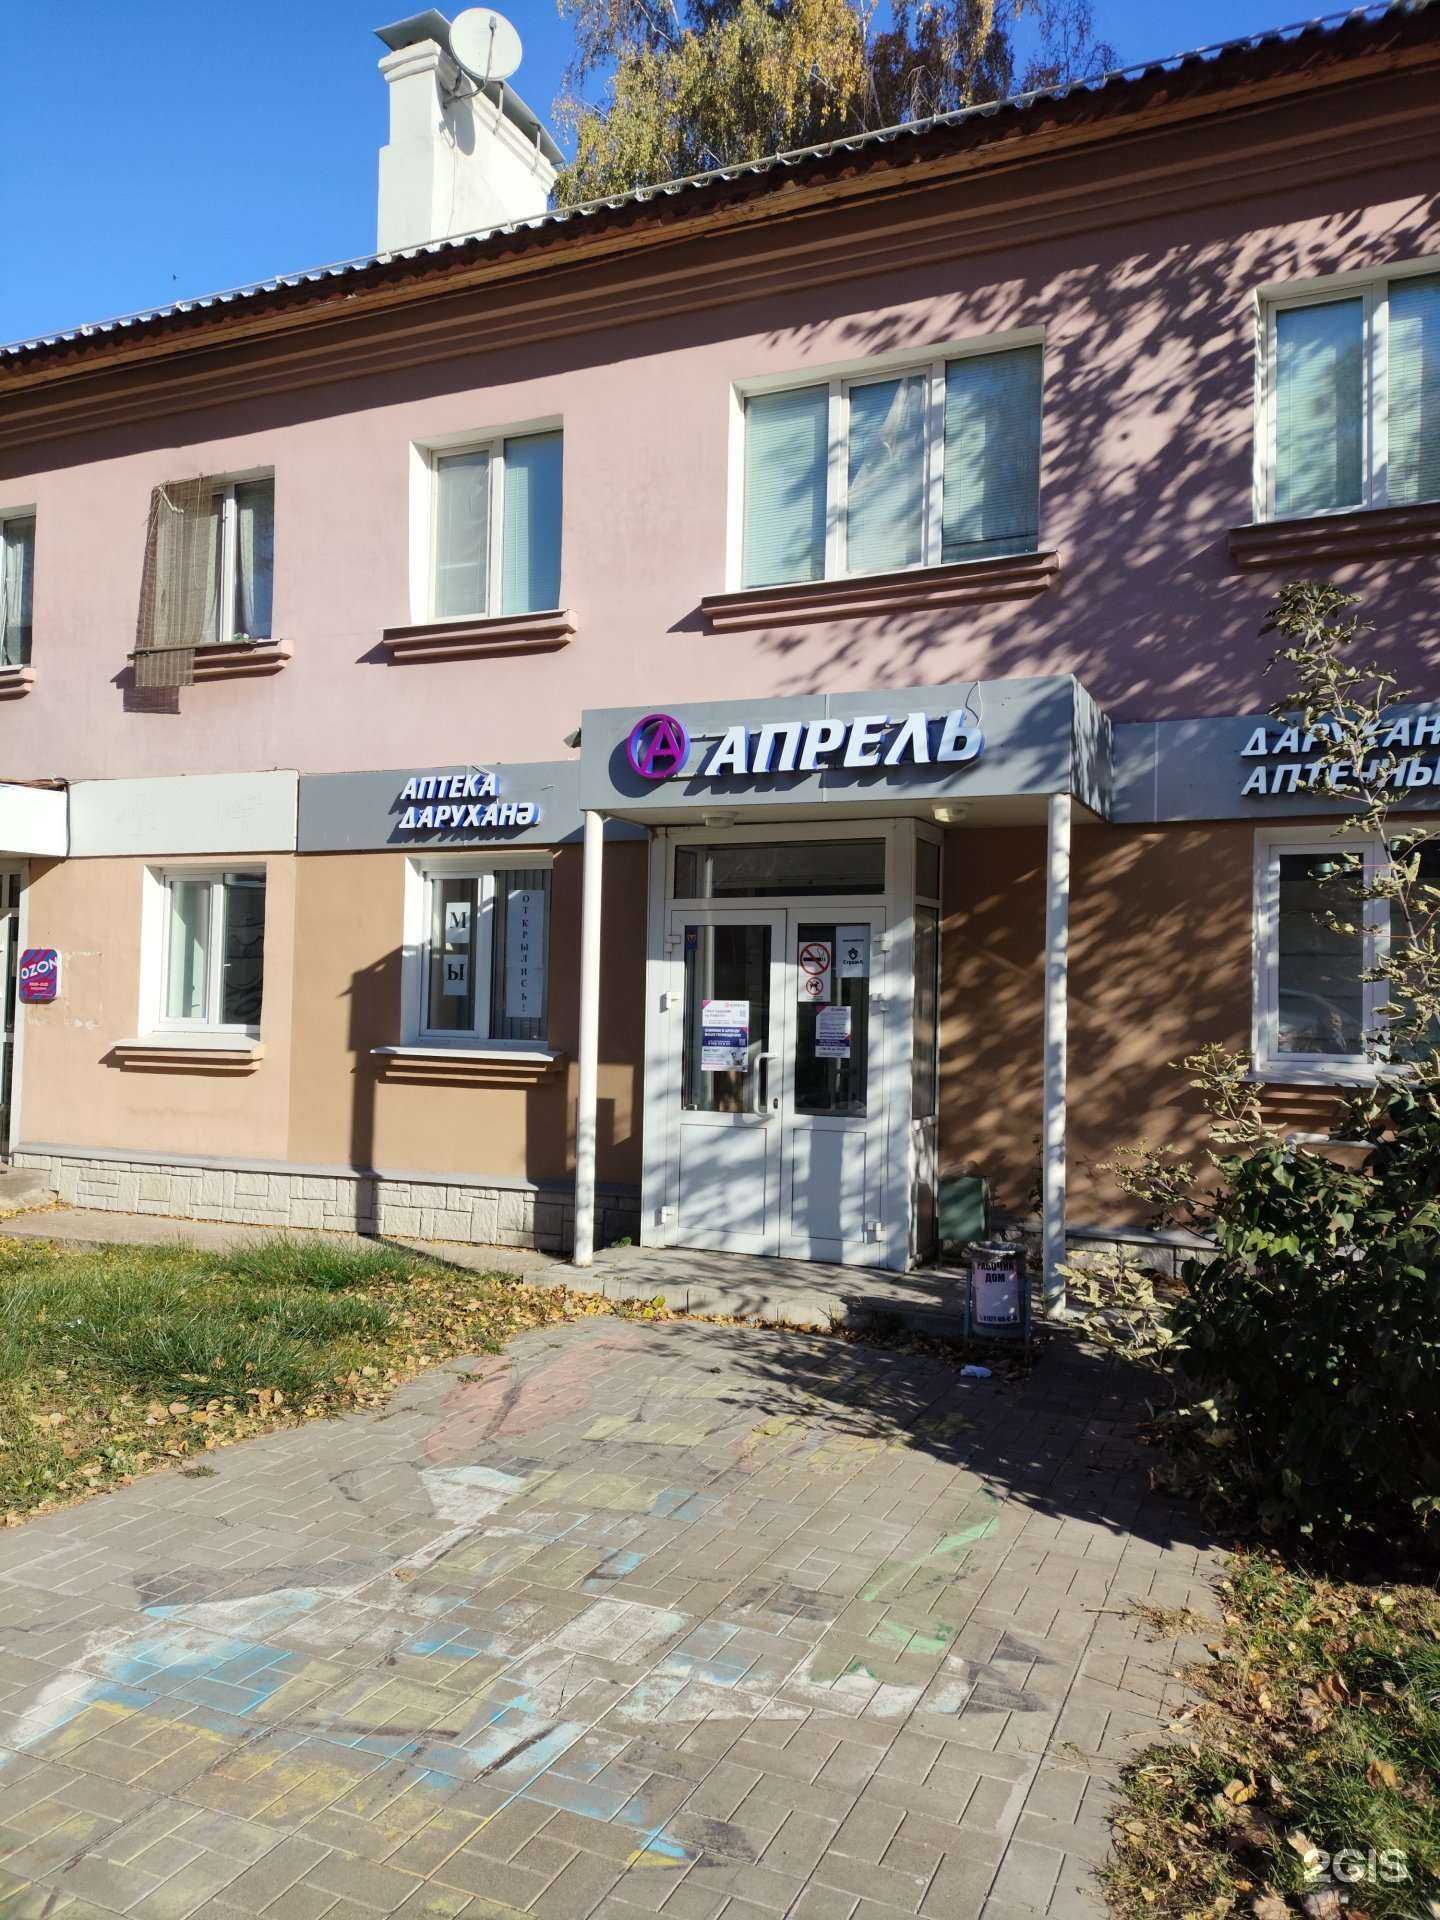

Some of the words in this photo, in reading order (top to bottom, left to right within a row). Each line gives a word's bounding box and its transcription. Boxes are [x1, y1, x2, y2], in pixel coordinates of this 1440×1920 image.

[704, 709, 985, 776] АПРЕЛЬ
[400, 773, 500, 800] АПТЕКА
[399, 802, 540, 829] ДАРУХАНӘ
[21, 956, 58, 979] OZON
